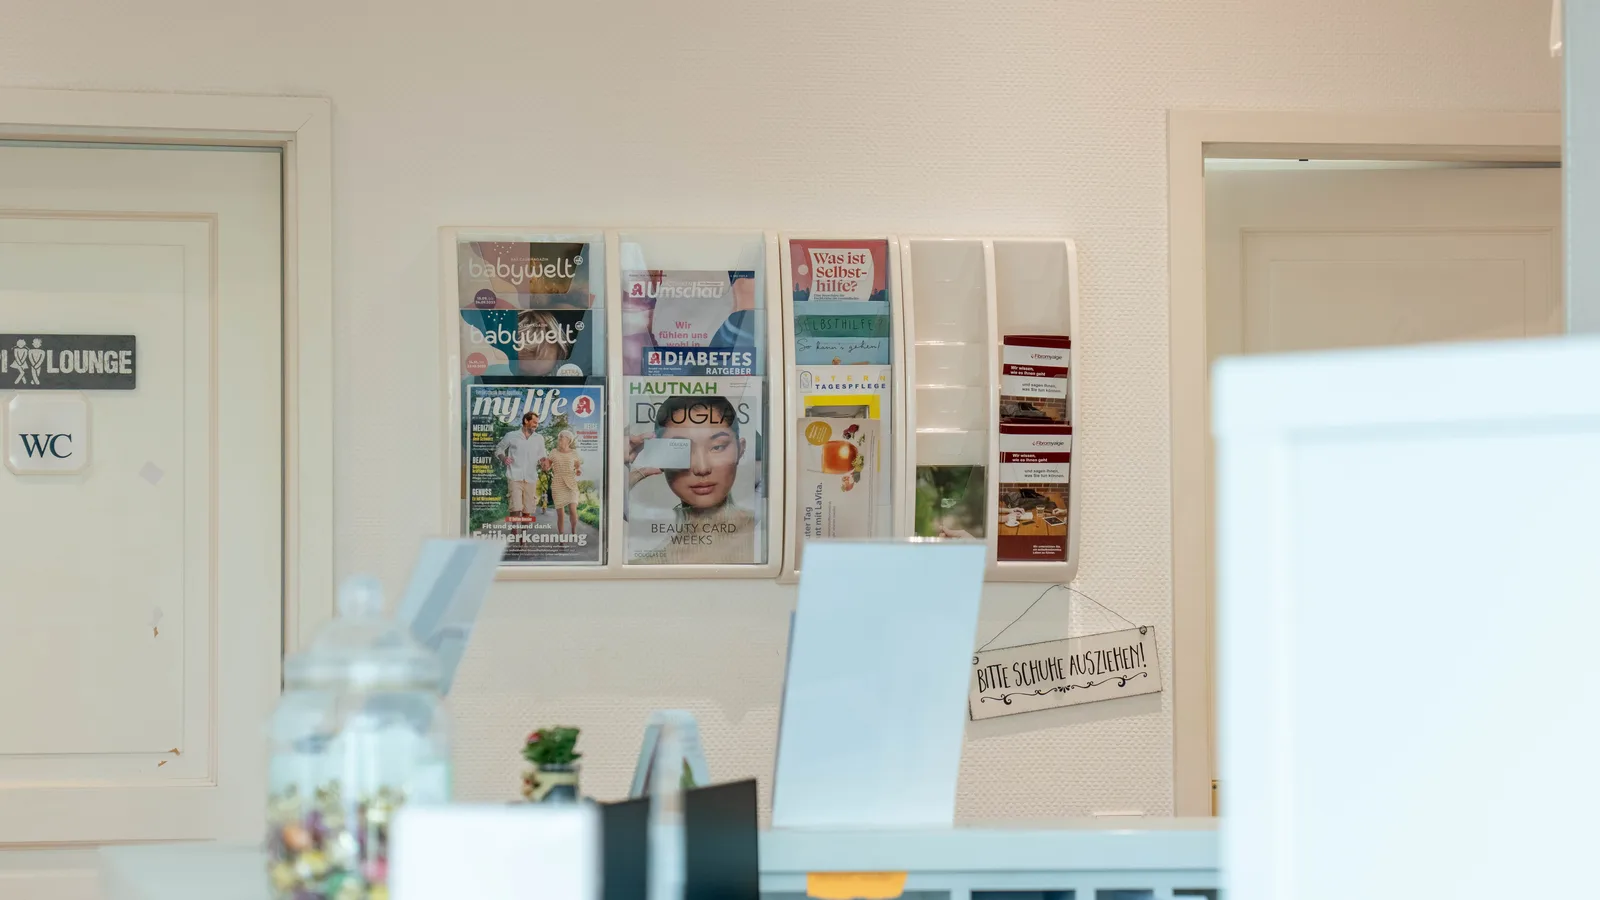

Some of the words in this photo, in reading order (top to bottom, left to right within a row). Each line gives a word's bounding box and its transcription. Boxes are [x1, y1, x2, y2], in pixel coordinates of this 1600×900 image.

[814, 252, 844, 264] Was
[847, 252, 866, 264] ist
[468, 256, 576, 286] babywelt
[816, 266, 868, 278] Selbst-
[647, 281, 724, 298] Umschau
[816, 280, 857, 292] hilfe?
[470, 324, 577, 352] babywelt
[659, 331, 688, 339] fühlen
[47, 350, 132, 374] LOUNGE
[665, 352, 752, 366] DiABETES
[630, 382, 717, 394] HAUTNAH
[472, 396, 520, 424] my
[523, 388, 568, 423] life
[635, 402, 750, 424] DOUGLAS
[18, 434, 73, 458] WC
[814, 482, 822, 510] LaVita.
[804, 506, 813, 522] Tag
[508, 523, 533, 532] gesund
[651, 523, 698, 533] BEAUTY
[702, 523, 736, 533] CARD
[671, 535, 712, 545] WEEKS
[977, 664, 1011, 694] BITTE
[1013, 656, 1066, 687] SCHUHE
[1069, 642, 1147, 676] AUSZIEHEN!
